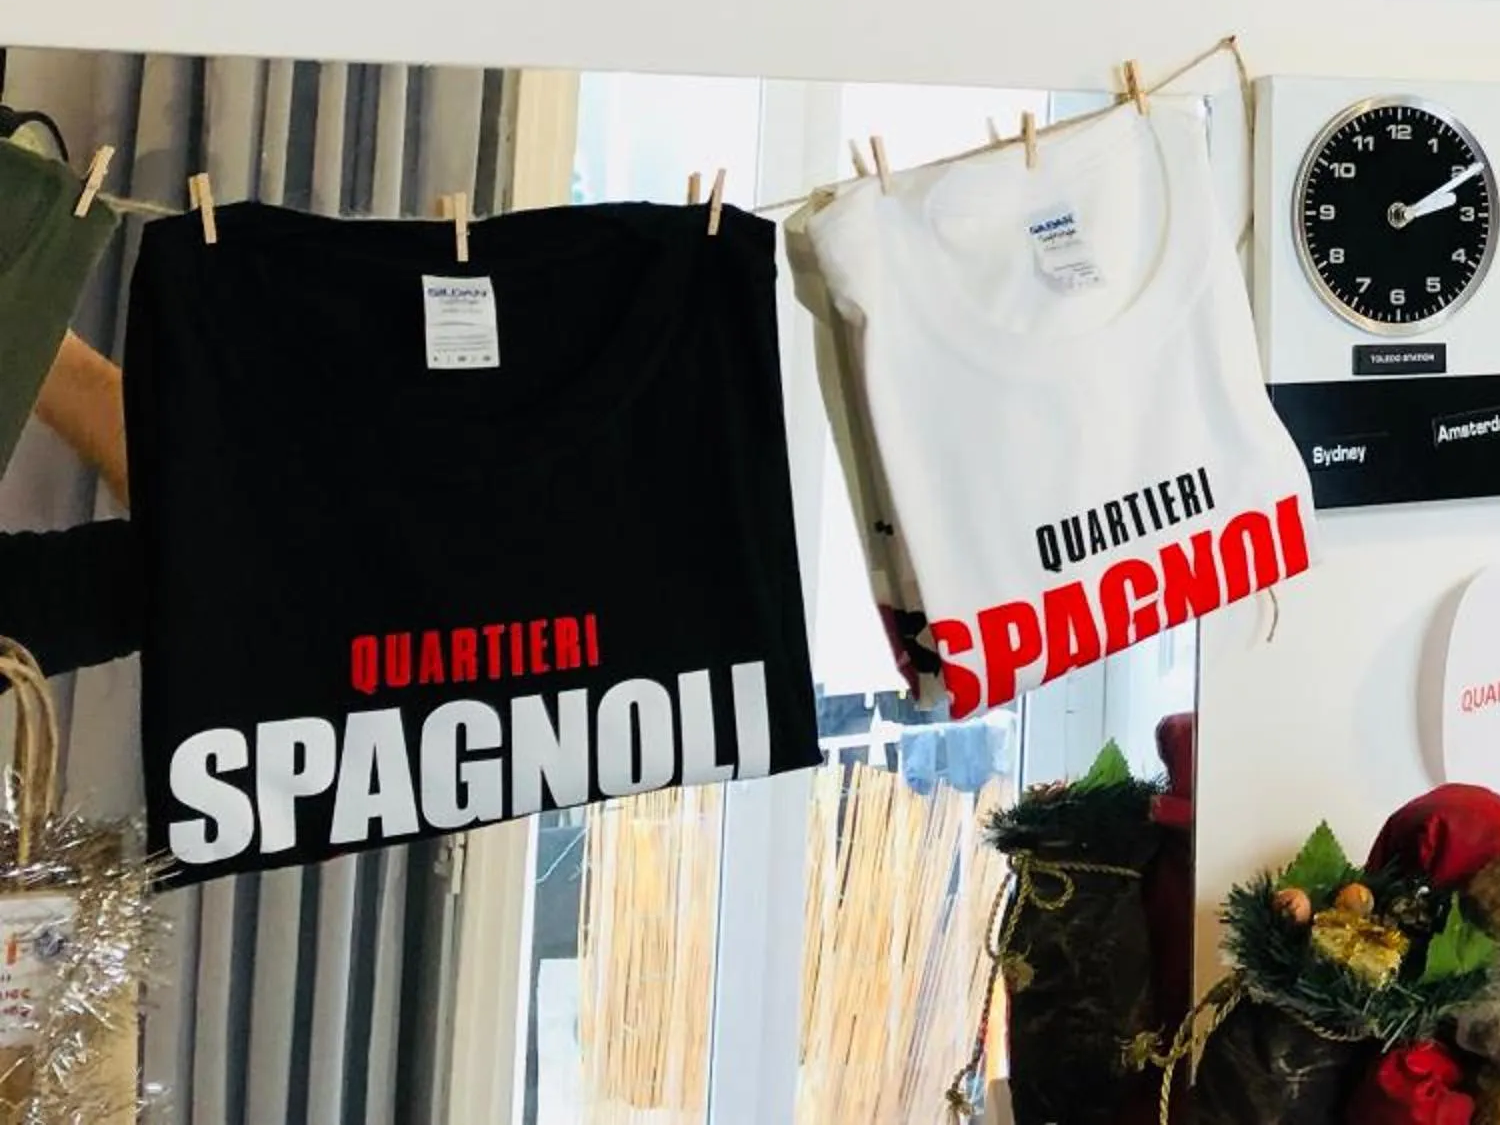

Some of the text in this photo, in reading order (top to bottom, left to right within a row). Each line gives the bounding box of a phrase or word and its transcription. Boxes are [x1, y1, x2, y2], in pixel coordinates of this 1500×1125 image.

[1386, 124, 1412, 140] 12
[1352, 135, 1374, 151] 11
[1427, 138, 1438, 153] 1
[1329, 162, 1356, 178] 10
[1319, 204, 1335, 220] 9
[1460, 206, 1475, 222] 3
[1329, 248, 1345, 264] 8
[1451, 248, 1467, 264] 4
[1355, 277, 1371, 293] 7
[1426, 277, 1441, 293] 5
[1390, 289, 1405, 305] 6
[1312, 442, 1368, 465] Sydney
[1035, 466, 1216, 573] QUARTIERI
[350, 613, 601, 696] QUARTIERI
[168, 659, 771, 866] SPAGNOLI
